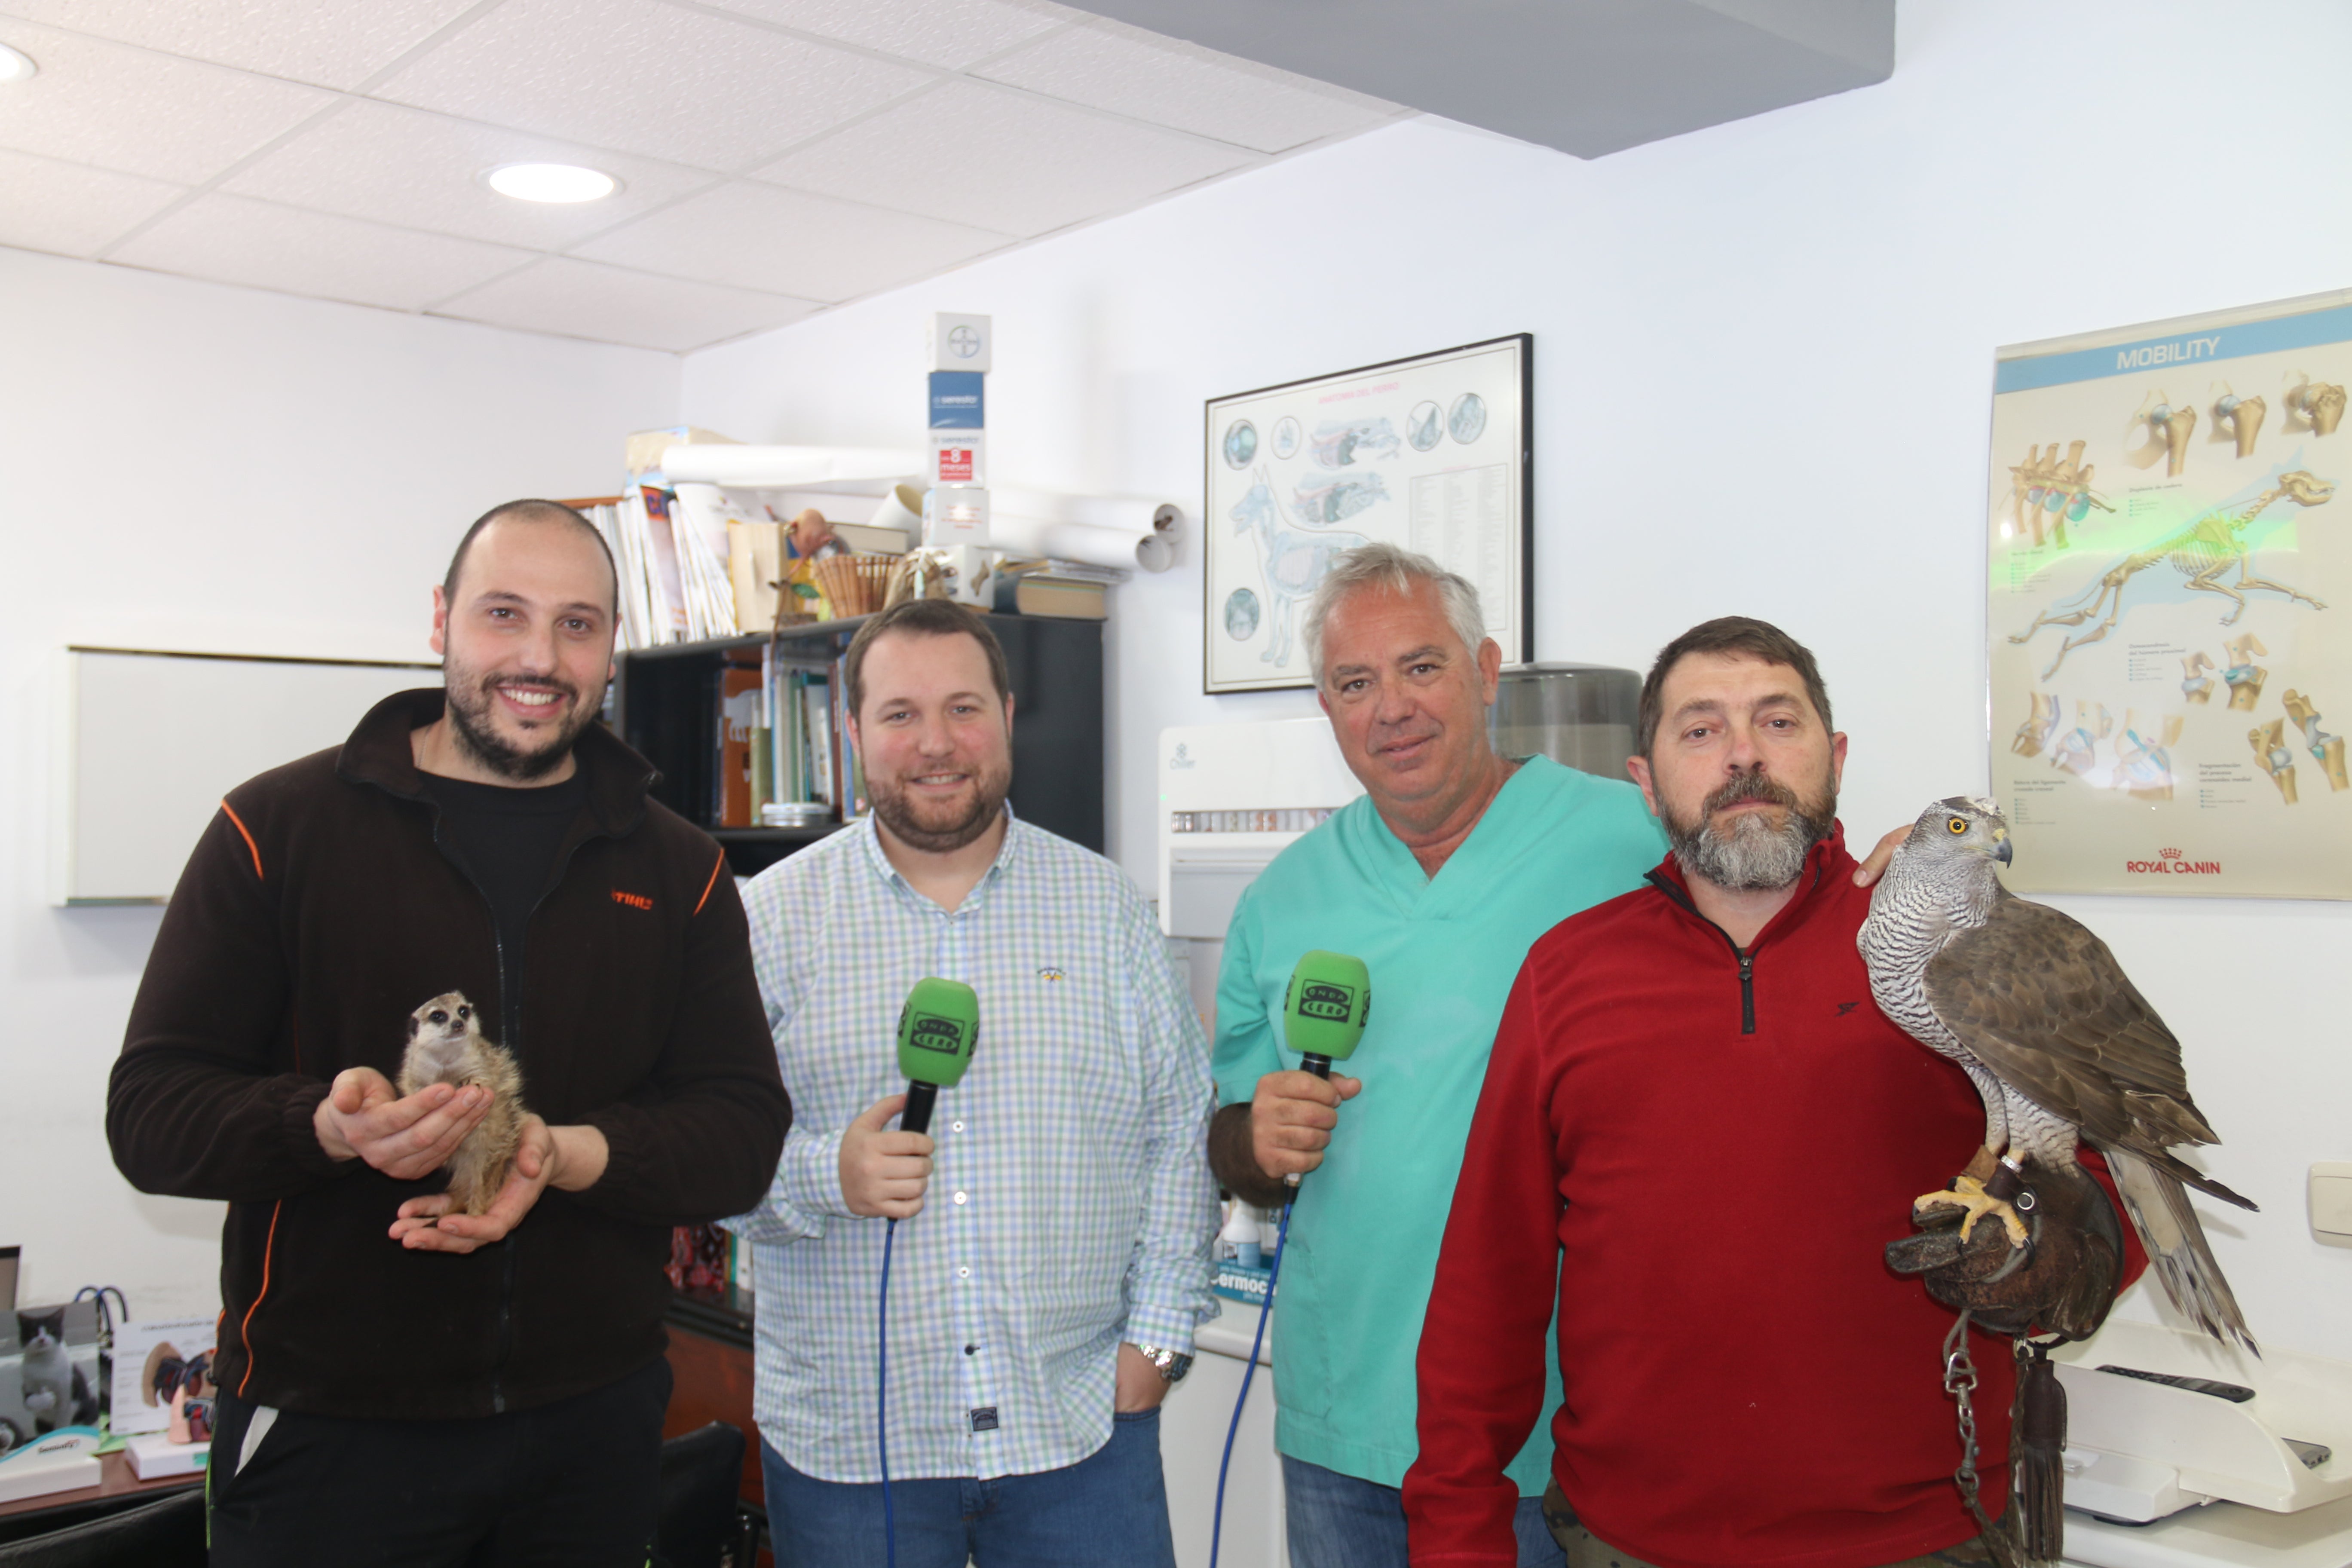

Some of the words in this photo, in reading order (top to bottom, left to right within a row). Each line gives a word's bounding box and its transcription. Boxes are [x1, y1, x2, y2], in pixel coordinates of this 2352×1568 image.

[2116, 336, 2221, 370] MOBILITY
[950, 447, 962, 463] 8
[2127, 861, 2171, 873] ROYAL
[2174, 861, 2221, 874] CANIN
[1308, 988, 1344, 1001] ONDA
[1308, 1002, 1342, 1015] CERO
[919, 1035, 953, 1048] CERO
